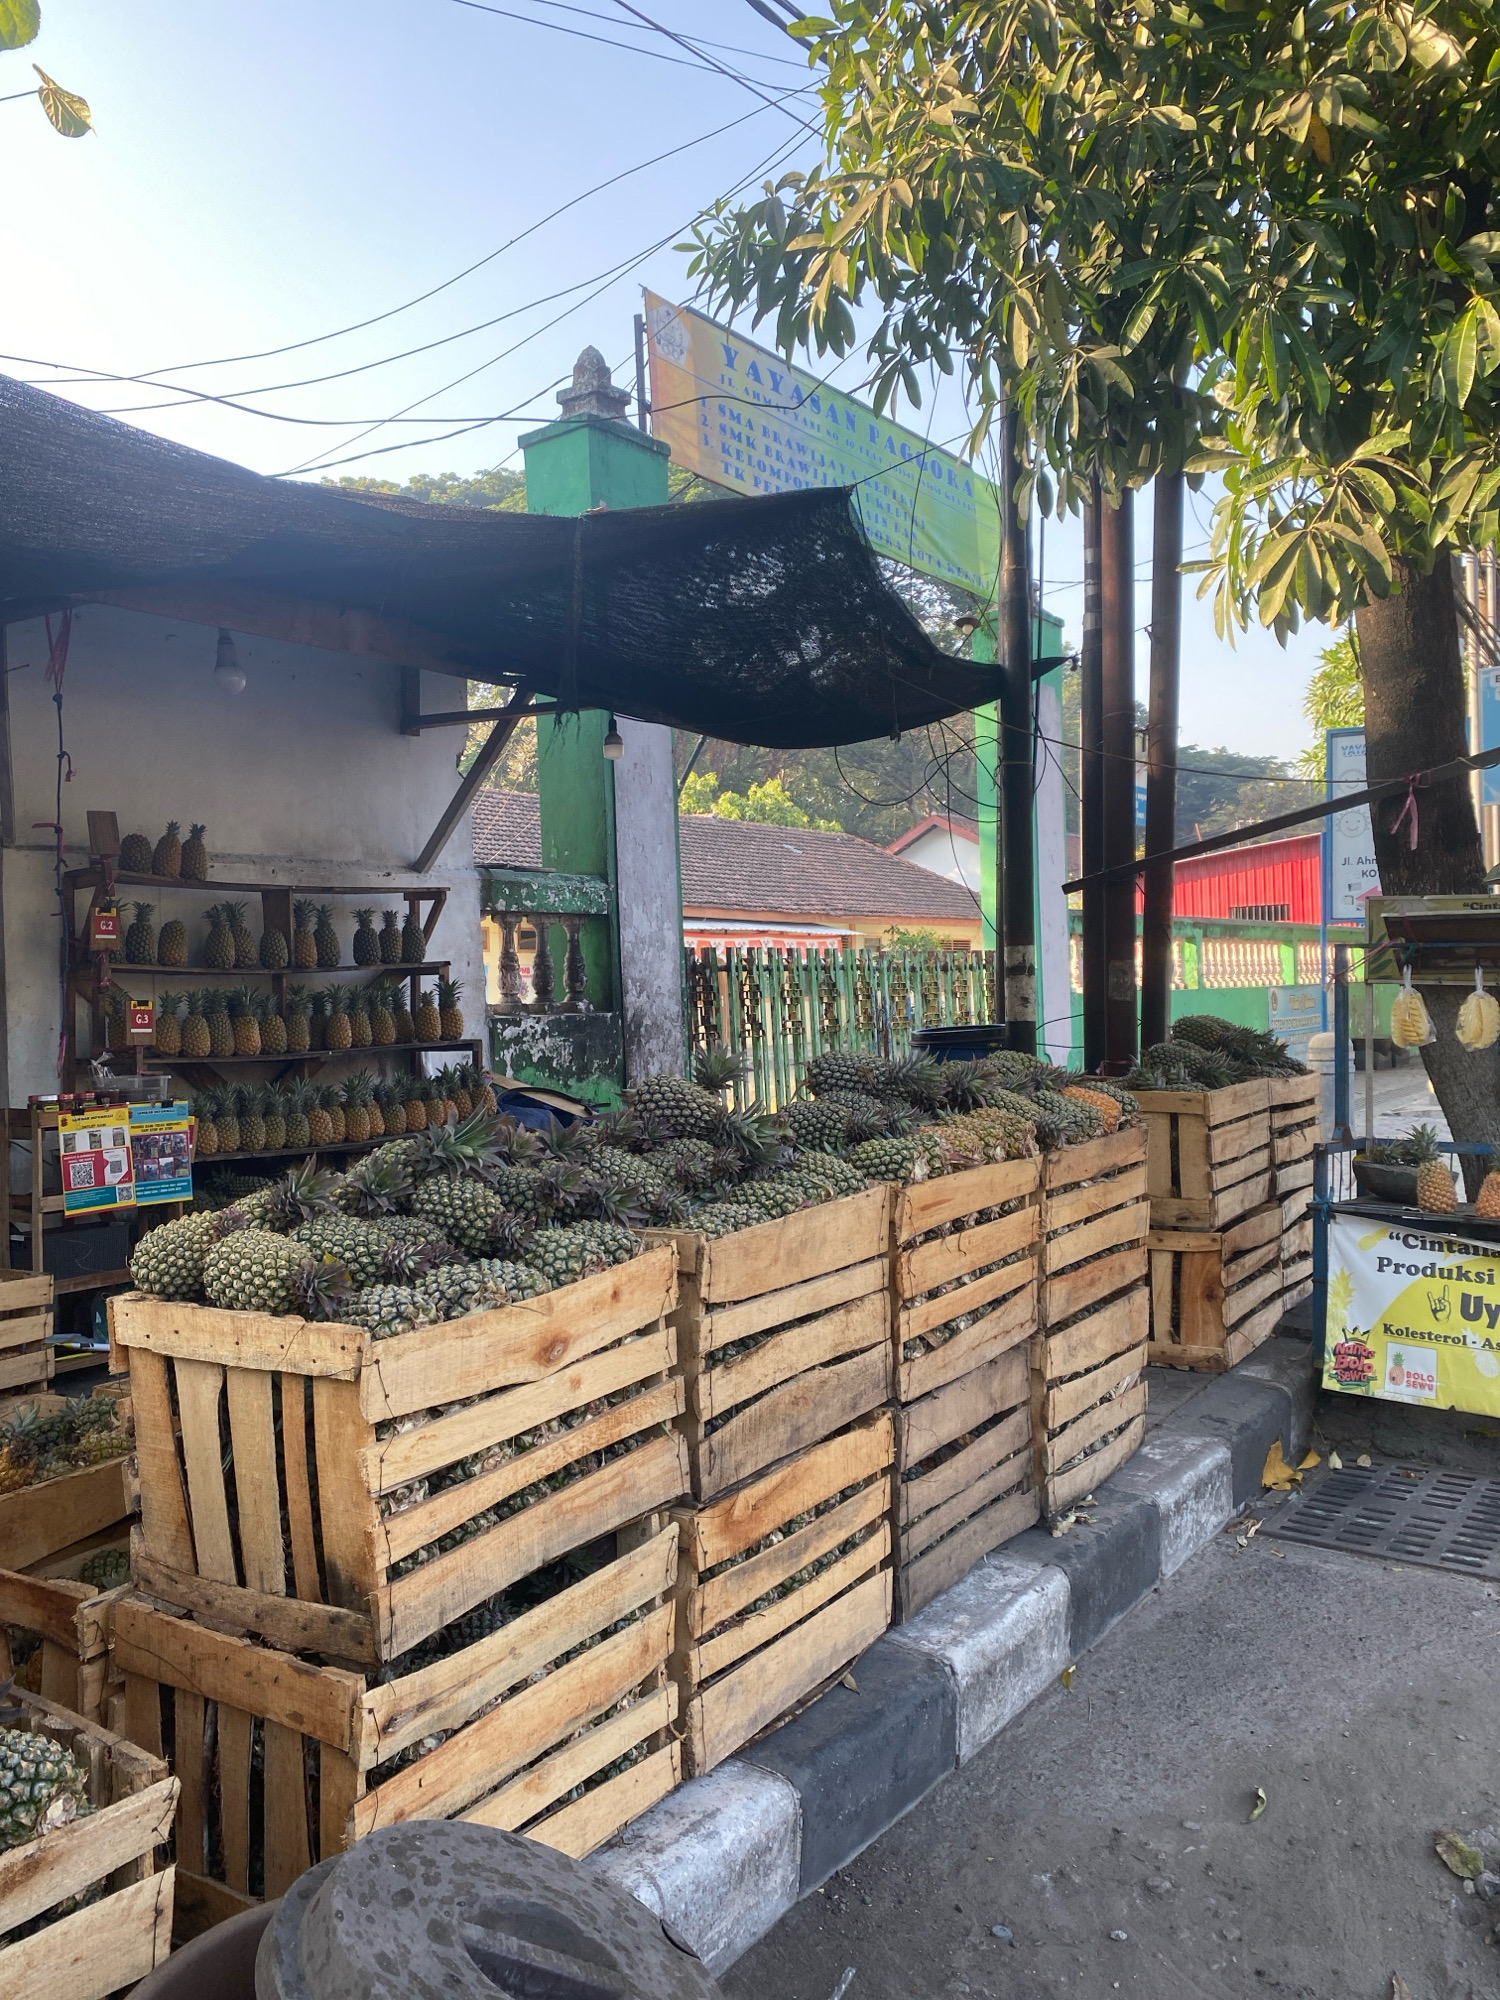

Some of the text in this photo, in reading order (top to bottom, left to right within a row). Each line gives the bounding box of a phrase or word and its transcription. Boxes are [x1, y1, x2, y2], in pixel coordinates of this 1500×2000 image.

[720, 342, 974, 498] YAYASAN PAGGORA
[701, 414, 713, 430] 2.
[719, 423, 757, 451] SMK
[717, 403, 755, 431] SMA
[762, 424, 857, 481] BRAWIJAYA
[863, 474, 915, 510] KEDIRI
[720, 459, 747, 482] TK
[1361, 869, 1379, 878] KO
[135, 1013, 149, 1025] G.3
[1376, 1256, 1495, 1285] Produksi
[1383, 1322, 1467, 1346] Kolesterol
[1334, 1342, 1376, 1359] Nanas
[1334, 1354, 1374, 1373] Bolo
[1405, 1370, 1435, 1383] BOLO
[1405, 1380, 1434, 1391] SEWU
